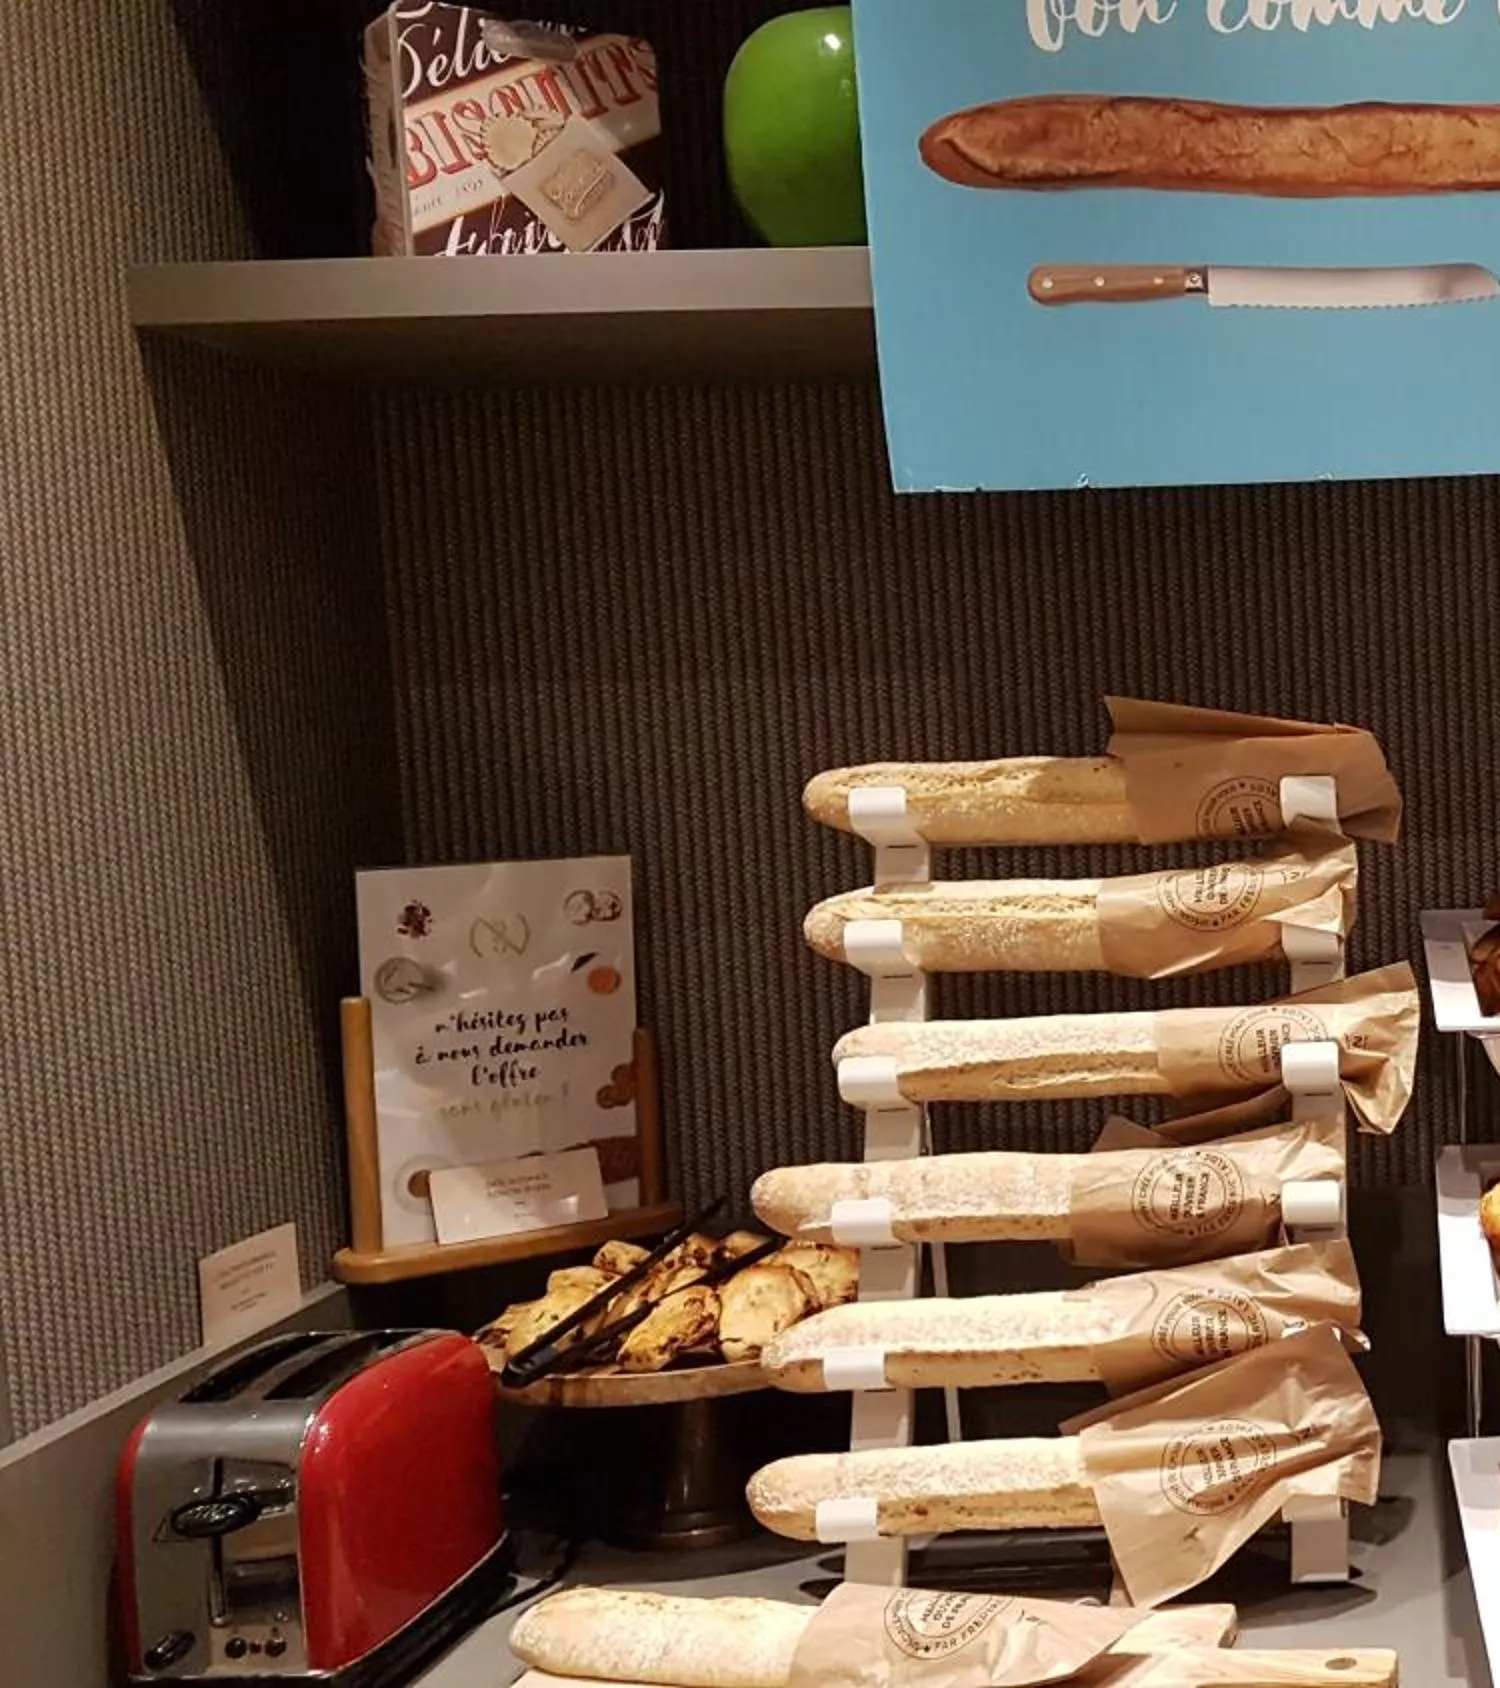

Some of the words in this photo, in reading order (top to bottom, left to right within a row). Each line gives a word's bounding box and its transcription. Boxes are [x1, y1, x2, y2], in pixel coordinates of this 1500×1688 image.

[535, 1007, 571, 1034] pas
[415, 1046, 432, 1065] à
[437, 1044, 481, 1062] nous
[488, 1027, 588, 1058] demander
[471, 1058, 539, 1089] l'offre
